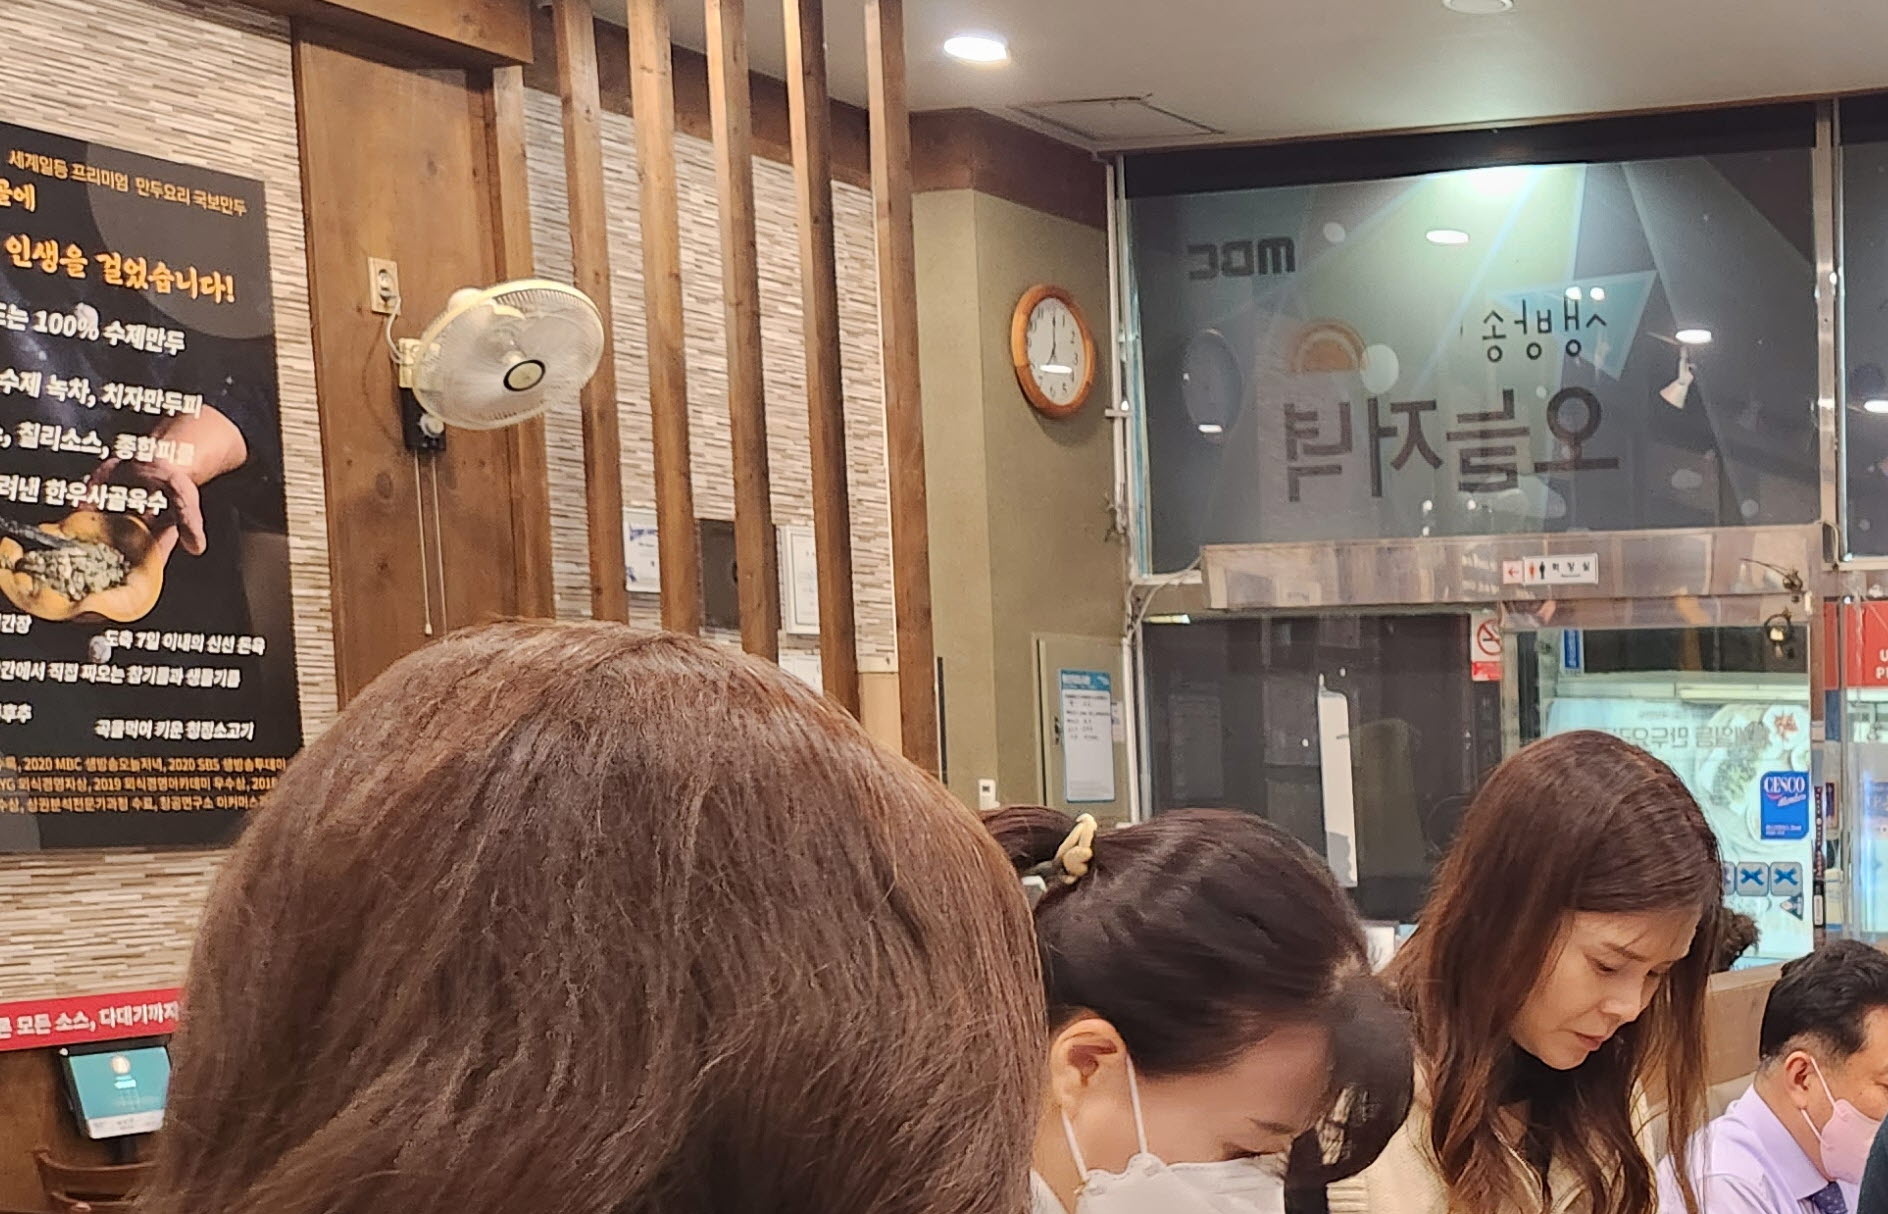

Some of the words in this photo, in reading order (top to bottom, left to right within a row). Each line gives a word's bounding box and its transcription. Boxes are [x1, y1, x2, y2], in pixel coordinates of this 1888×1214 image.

[8, 150, 68, 180] 세계일등
[70, 163, 129, 193] 프리미엄
[135, 177, 191, 206] 만두요리
[4, 234, 89, 279] 인생을
[94, 252, 236, 304] 걸었습니다!
[33, 309, 100, 341] 100%
[103, 321, 186, 356] 수제만두
[0, 368, 42, 399] 수제
[46, 374, 96, 408] 녹차,
[101, 383, 203, 419] 치자만두피
[17, 421, 110, 460] 칠리소스,
[135, 631, 160, 651] 7일
[161, 632, 205, 653] 이내의
[23, 756, 53, 771] 2020
[168, 757, 196, 771] 2020
[1763, 776, 1806, 793] CESCO
[17, 1013, 52, 1035] 모든
[55, 1011, 97, 1032] 소스,
